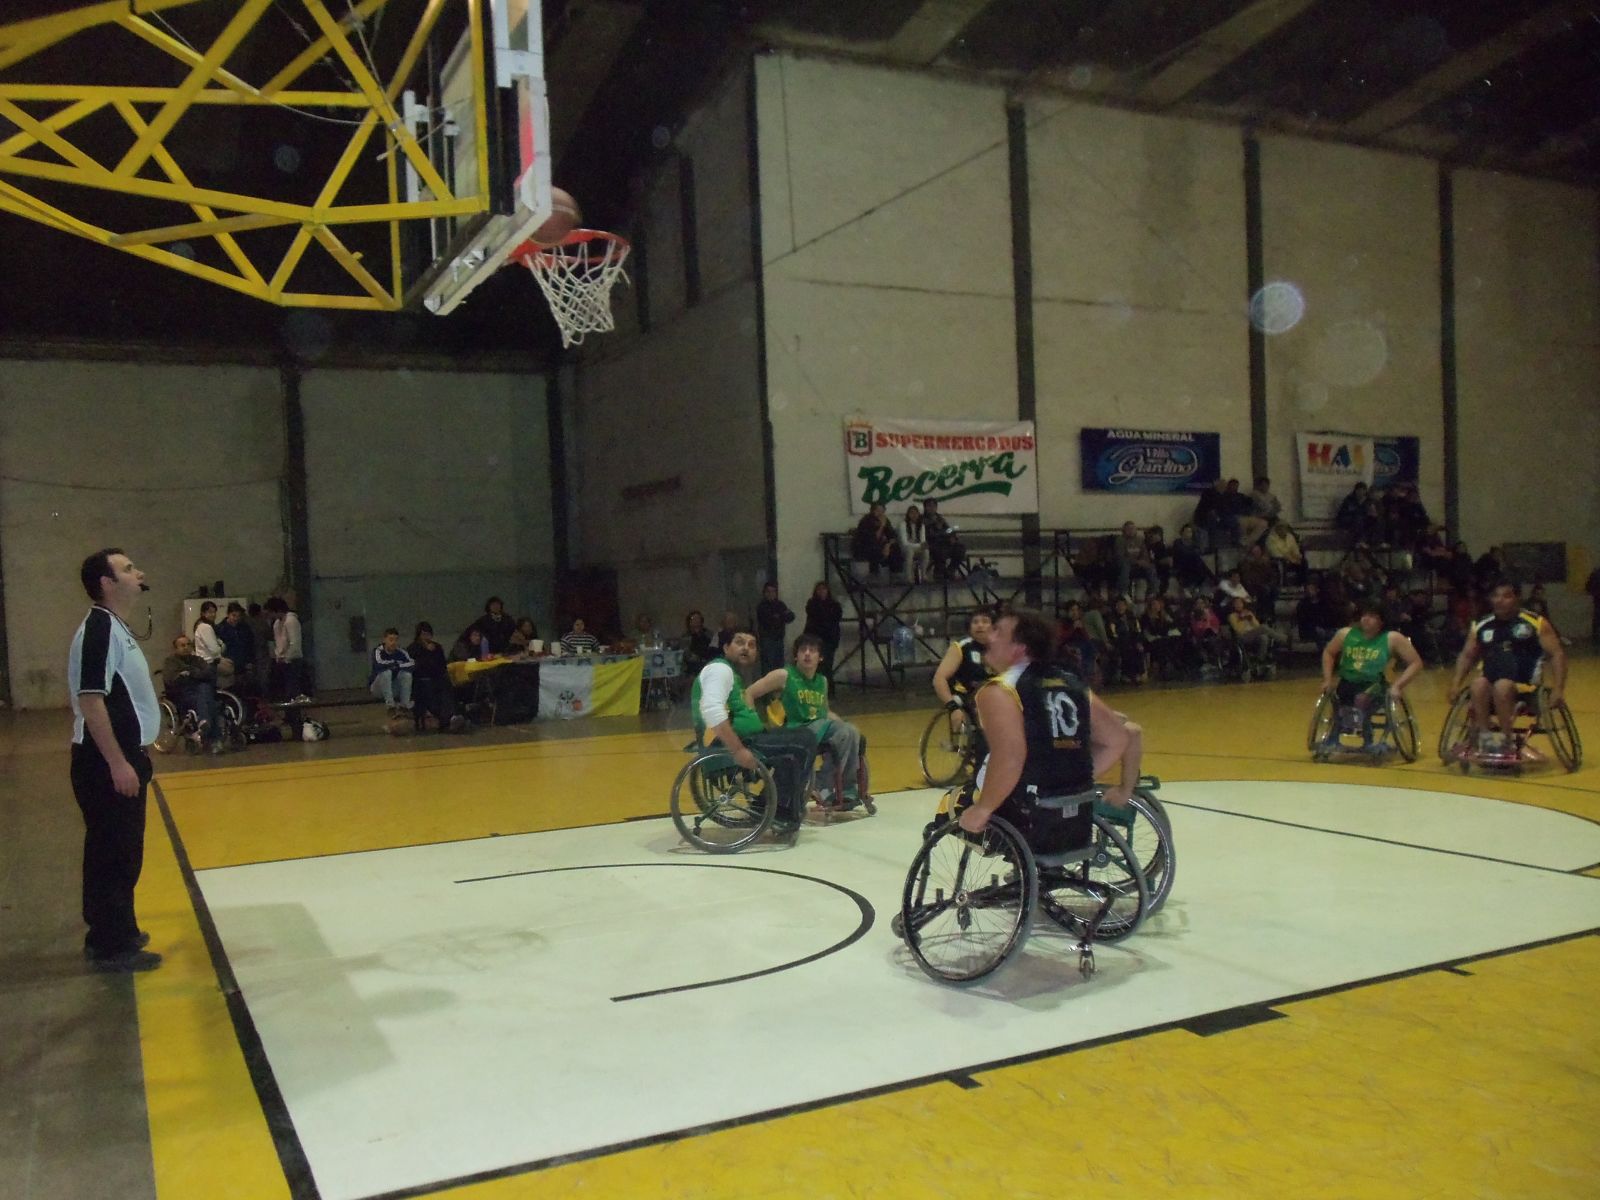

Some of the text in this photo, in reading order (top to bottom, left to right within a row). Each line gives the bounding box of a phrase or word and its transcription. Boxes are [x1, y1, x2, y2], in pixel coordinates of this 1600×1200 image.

[853, 432, 868, 449] B
[876, 432, 1033, 450] SUPERMERCADOS
[1107, 428, 1195, 443] AGUA MINERAL
[857, 452, 1028, 506] Becerra
[1045, 690, 1080, 737] 10
